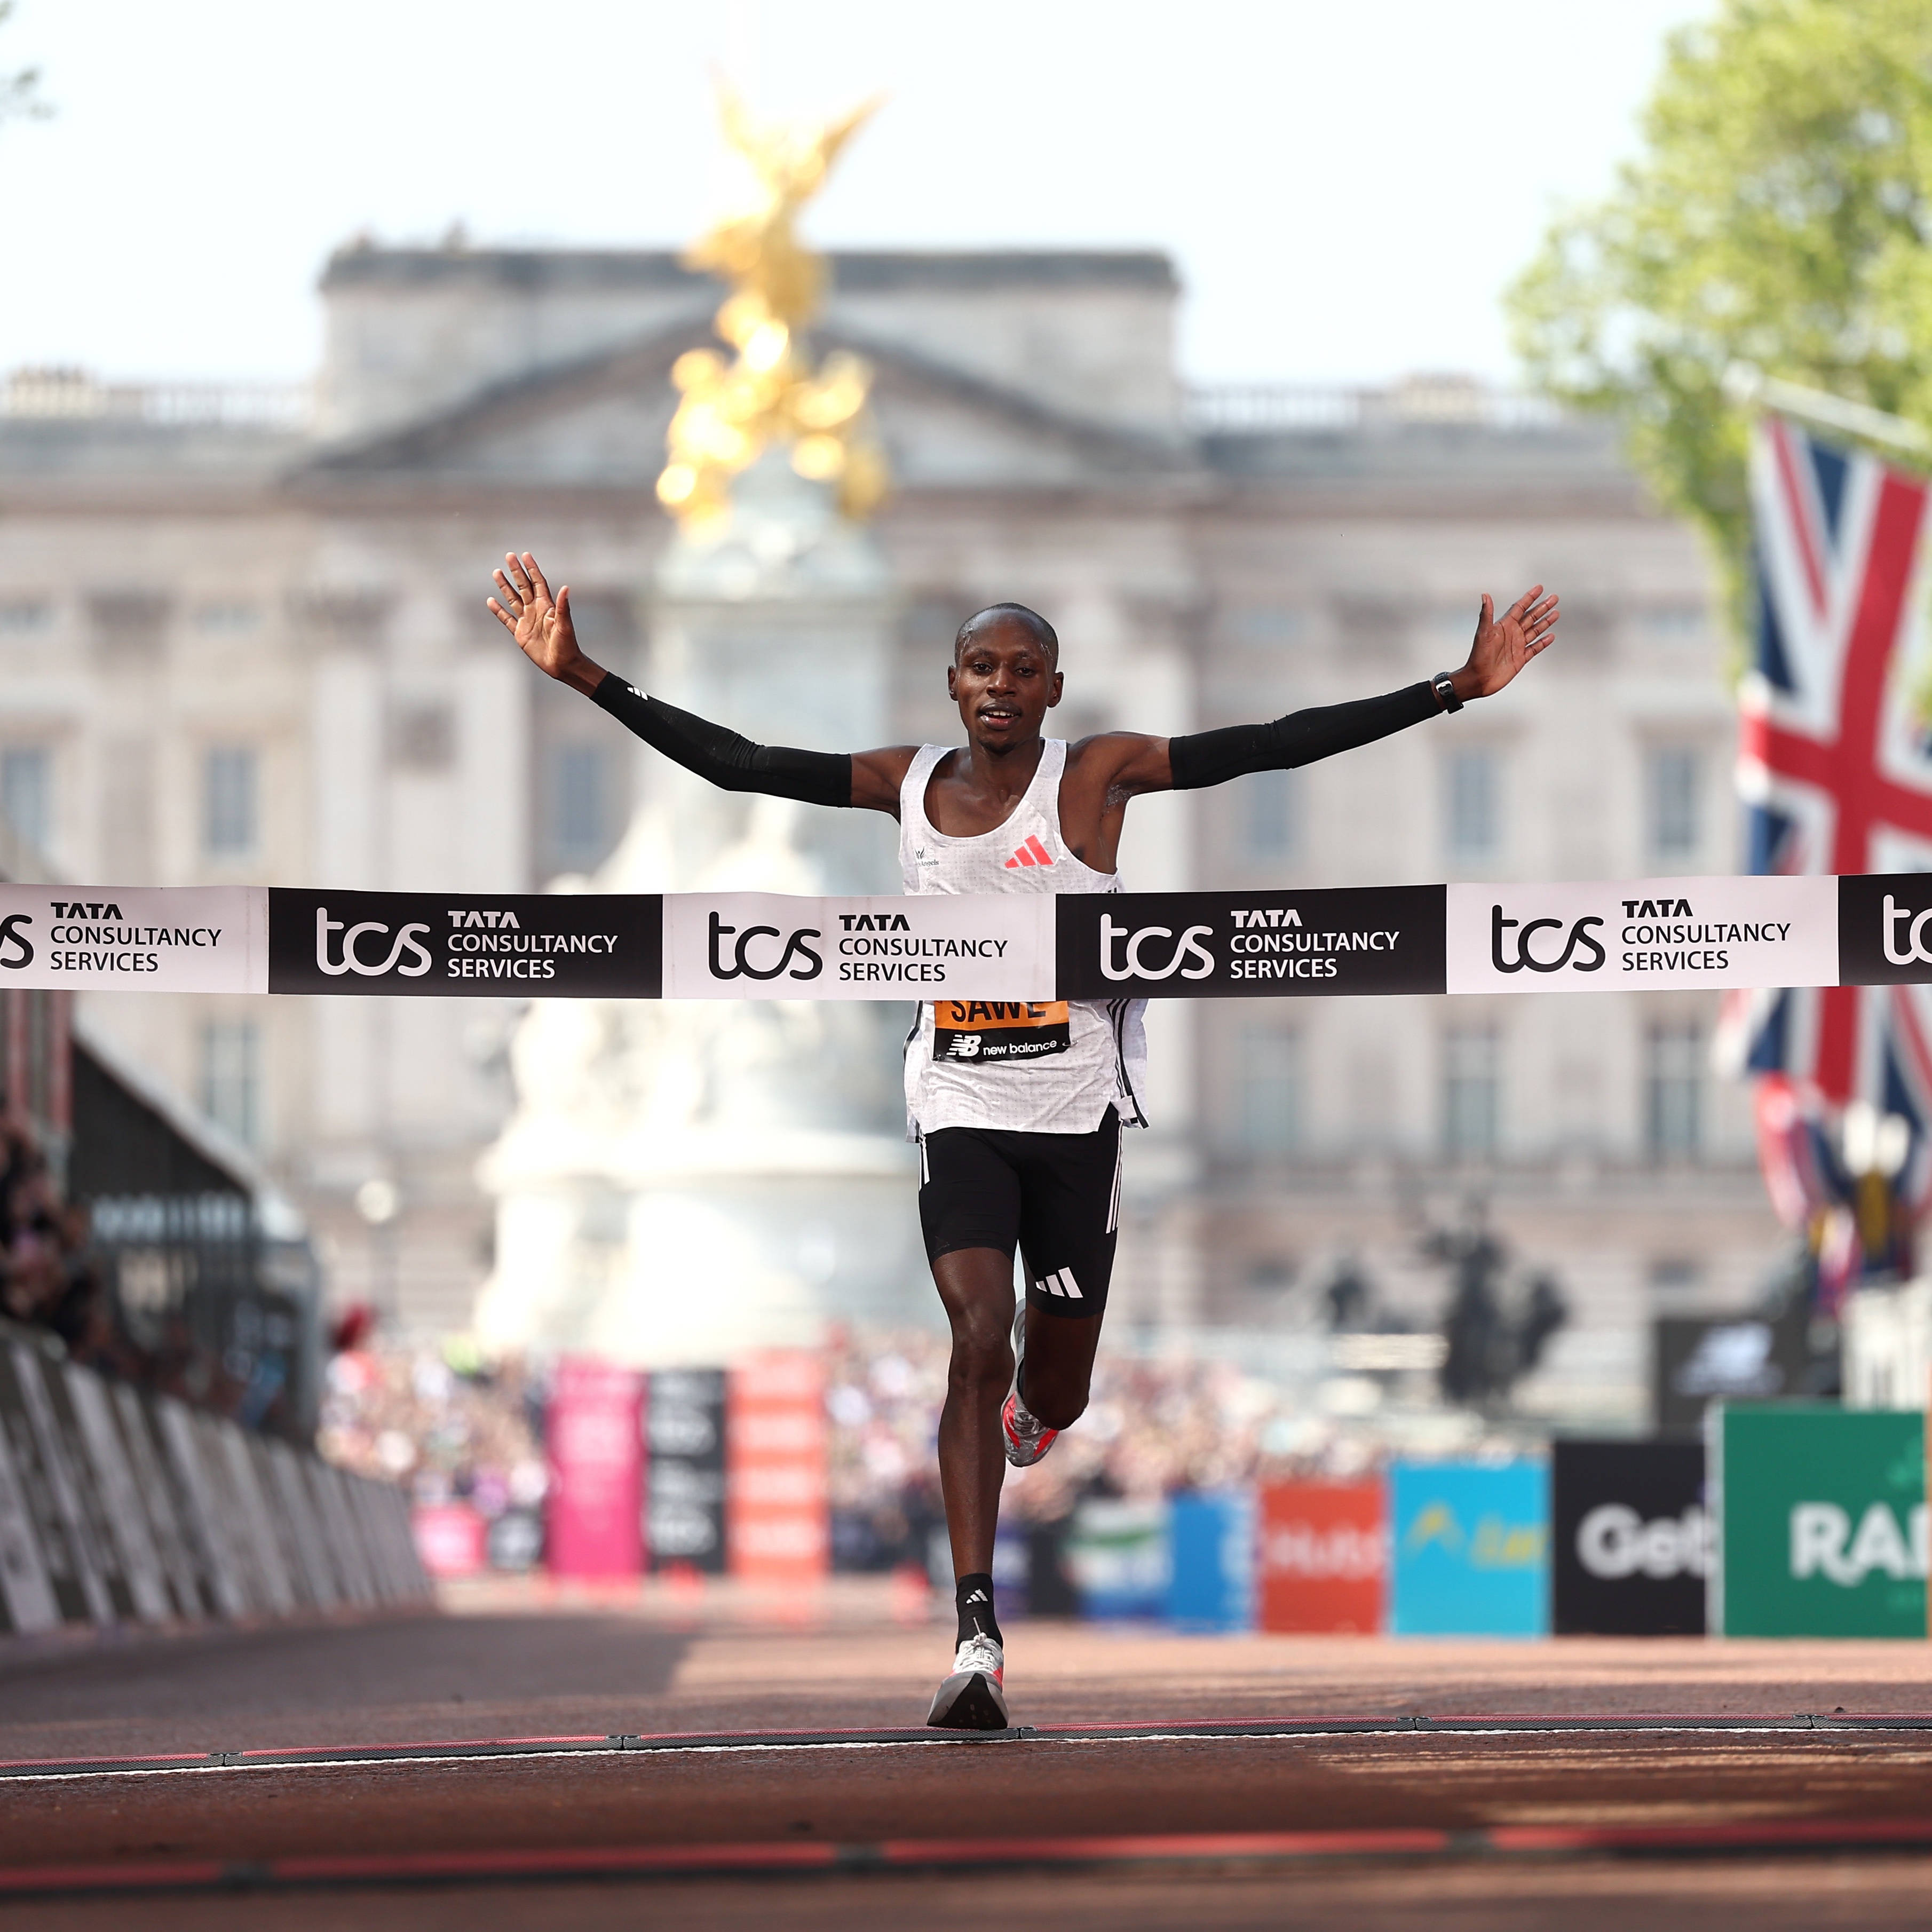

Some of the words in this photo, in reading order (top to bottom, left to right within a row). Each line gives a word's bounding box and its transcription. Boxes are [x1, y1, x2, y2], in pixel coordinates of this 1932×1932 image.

[921, 859, 939, 867] Angels
[50, 902, 123, 920] TATA
[448, 910, 520, 929] TATA
[1231, 909, 1303, 928] TATA
[1621, 899, 1693, 919] TATA
[838, 914, 910, 931] TATA
[1883, 894, 1932, 965] tc
[51, 925, 222, 947] CONSULTANCY
[316, 907, 432, 977] tcs
[448, 934, 618, 953] CONSULTANCY
[1230, 931, 1400, 953] CONSULTANCY
[1492, 905, 1606, 973] tcs
[1622, 923, 1791, 945] CONSULTANCY
[708, 911, 823, 980] tcs
[839, 938, 1008, 957] CONSULTANCY
[1100, 913, 1215, 981] tcs
[50, 951, 158, 972] SERVICES
[448, 958, 555, 979] SERVICES
[1230, 958, 1337, 979] SERVICES
[1622, 950, 1729, 971] SERVICES
[840, 962, 946, 982] SERVICES
[983, 1044, 1007, 1056] new
[1009, 1040, 1057, 1054] balance
